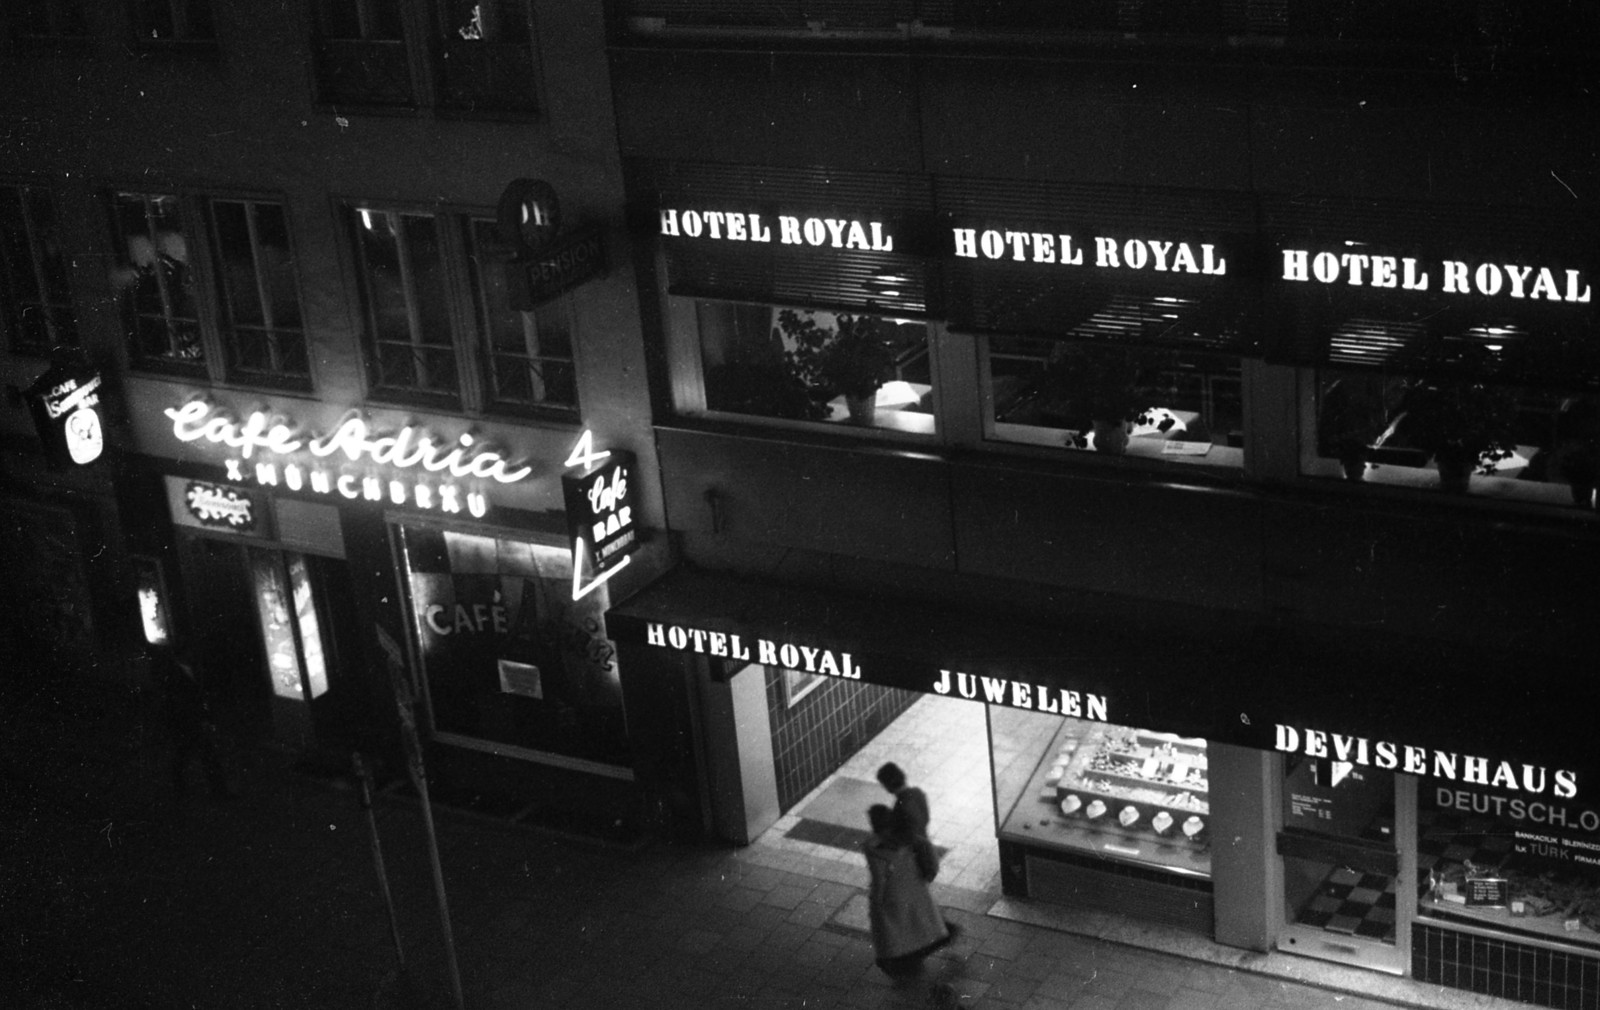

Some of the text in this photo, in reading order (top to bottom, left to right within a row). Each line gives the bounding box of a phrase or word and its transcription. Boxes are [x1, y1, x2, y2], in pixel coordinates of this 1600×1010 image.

[660, 209, 893, 252] HOTEL ROYAL
[953, 228, 1226, 276] HOTEL ROYAL
[1282, 249, 1591, 303] HOTEL ROYAL
[310, 418, 532, 483] Adria
[593, 506, 631, 542] BAR
[426, 588, 509, 636] CAFÉ
[648, 623, 860, 679] HOTEL ROYAL
[933, 669, 1107, 721] JUWELEN
[1275, 724, 1577, 798] DEVISENHAUS
